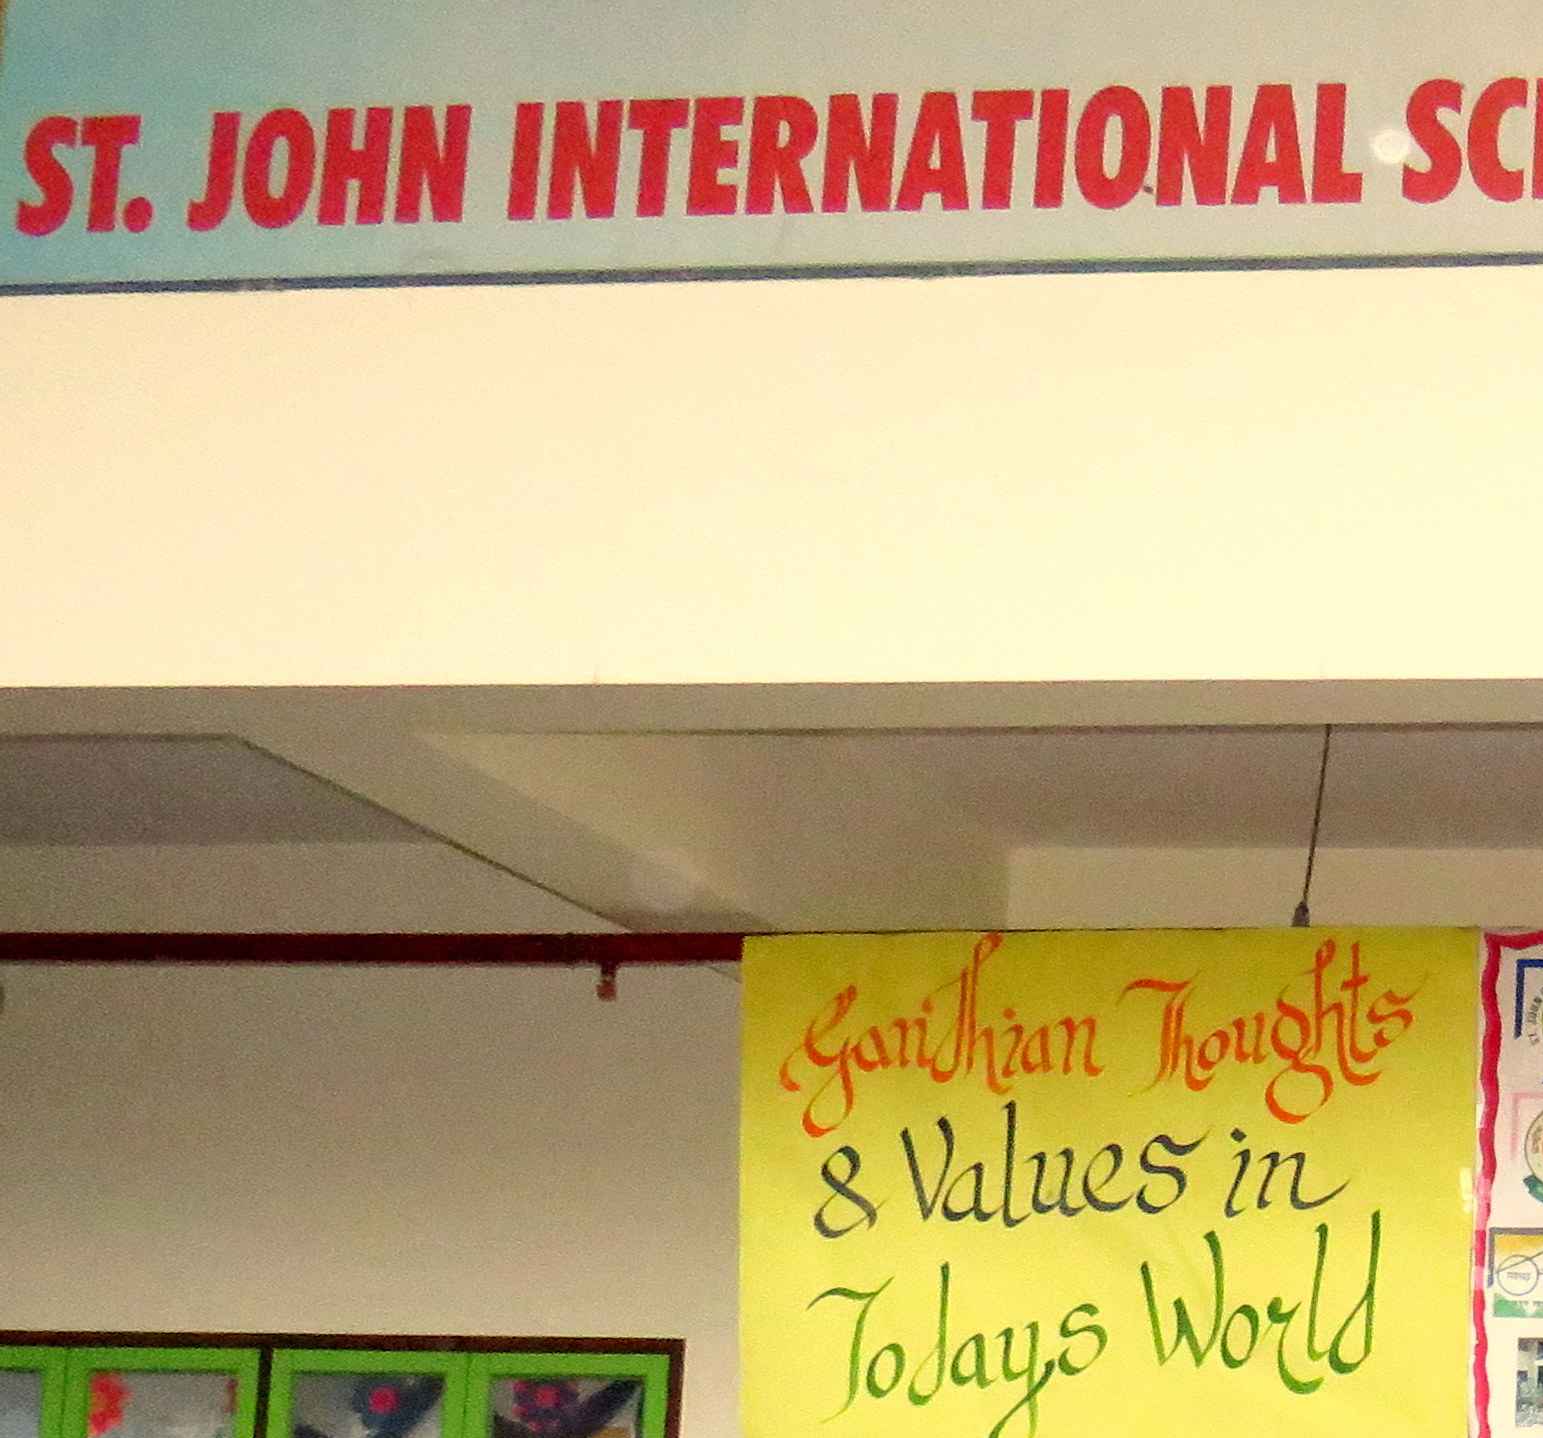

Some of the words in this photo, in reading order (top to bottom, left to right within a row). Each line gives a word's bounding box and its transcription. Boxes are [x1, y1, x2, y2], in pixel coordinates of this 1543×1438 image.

[15, 116, 153, 238] ST.
[188, 104, 472, 229] JOHN
[510, 82, 1363, 221] INTERNATIONAL
[1116, 938, 1429, 1124] Thoughts
[901, 1100, 1211, 1228] Values
[1223, 1128, 1351, 1219] in
[1140, 1207, 1383, 1395] World
